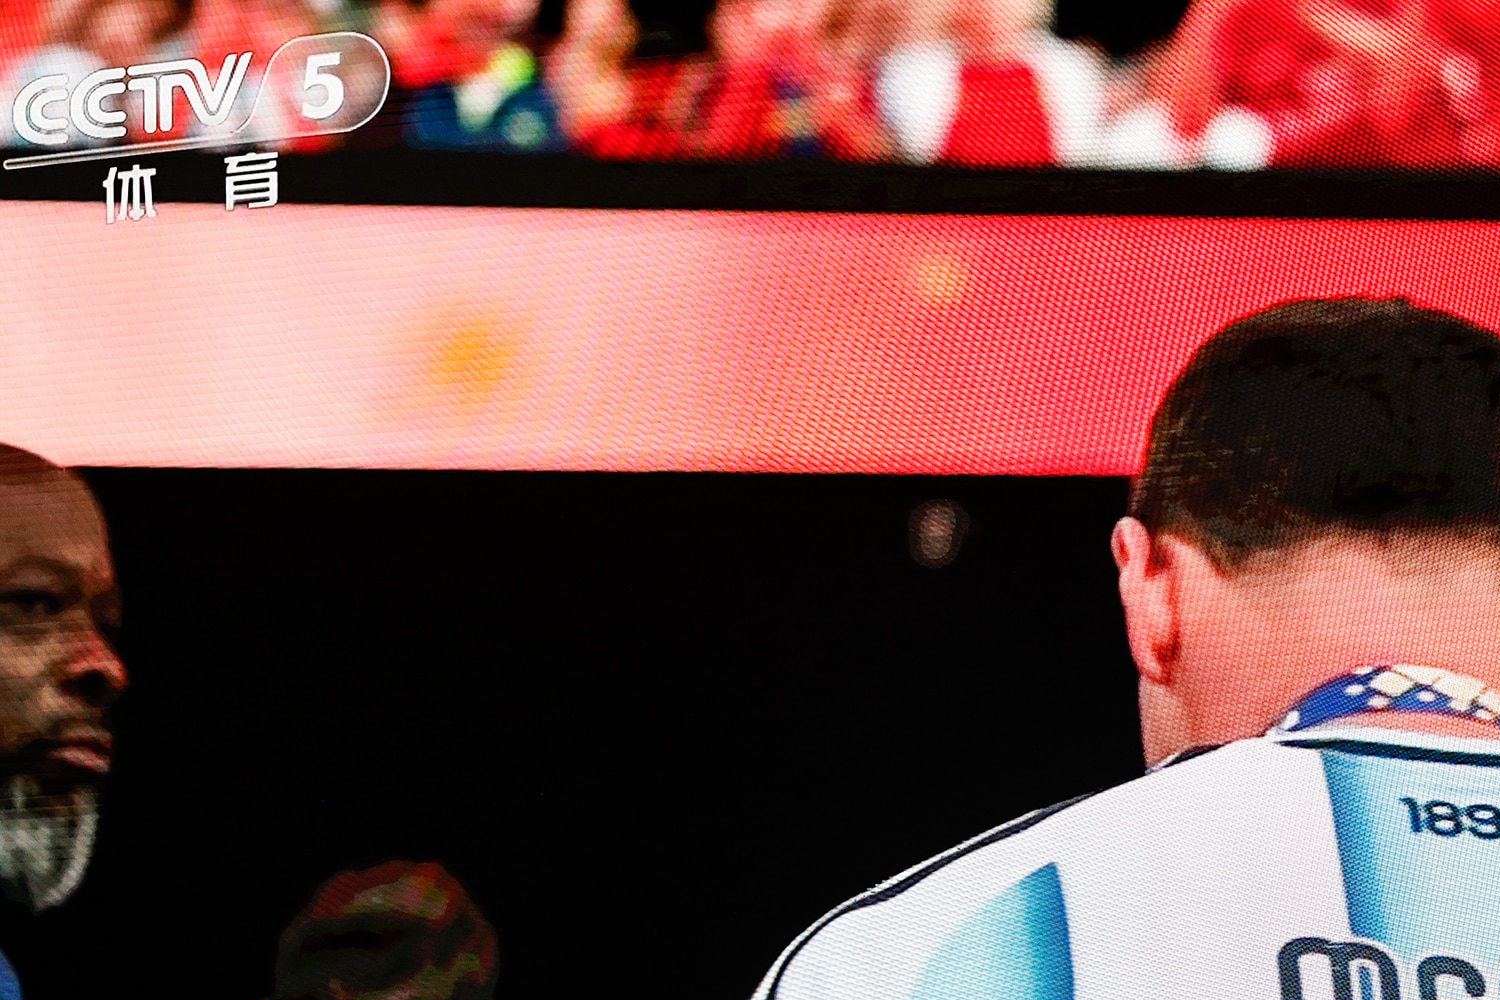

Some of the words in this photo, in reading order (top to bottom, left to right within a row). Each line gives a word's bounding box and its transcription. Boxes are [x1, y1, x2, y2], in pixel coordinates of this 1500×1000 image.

[12, 51, 254, 145] CCTV
[301, 52, 345, 120] 5
[102, 151, 279, 224] 体育
